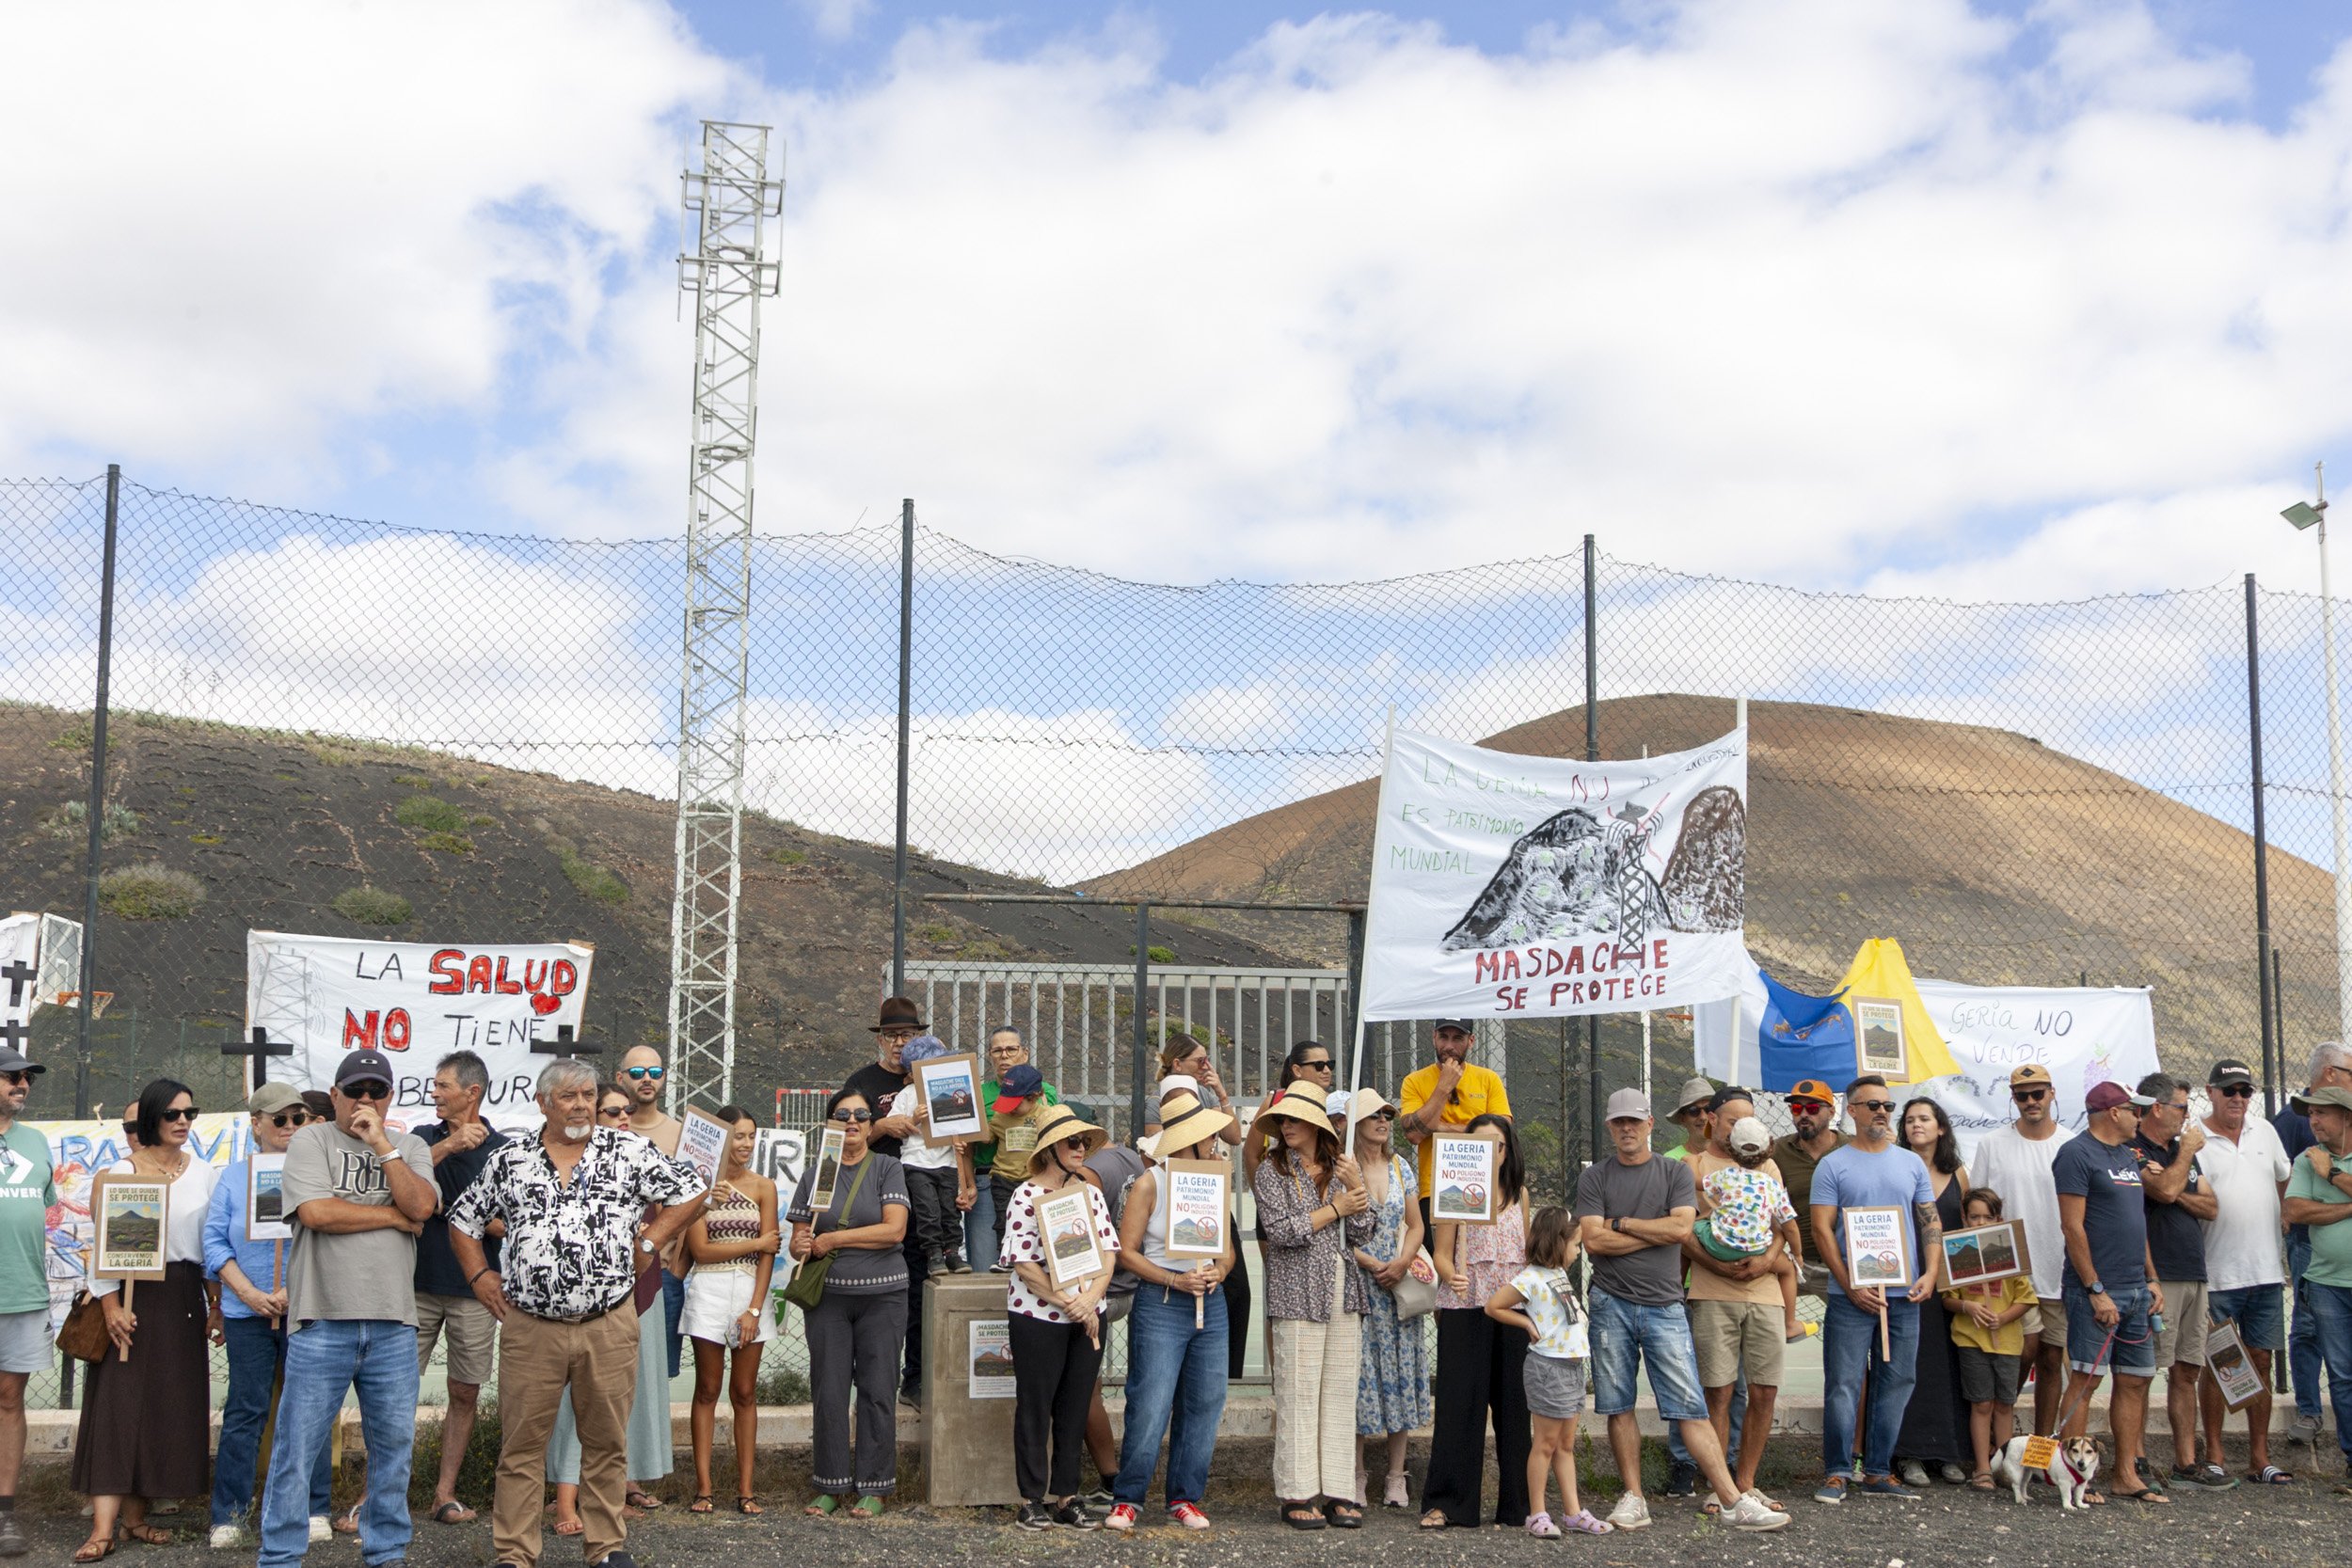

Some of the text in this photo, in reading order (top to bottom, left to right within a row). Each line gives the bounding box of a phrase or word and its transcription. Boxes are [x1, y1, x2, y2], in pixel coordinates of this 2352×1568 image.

[1423, 755, 1457, 787] LA
[1402, 804, 1430, 824] ES
[1475, 939, 1669, 984] MASDACHE
[357, 949, 577, 995] LA SALUD
[1495, 974, 1666, 1011] SE PROTEGE
[343, 1006, 412, 1052] NO
[2034, 1010, 2073, 1037] NO
[1974, 1035, 2051, 1066] VENDE
[688, 1128, 717, 1147] PATRIMONIO
[691, 1117, 721, 1140] LA GERIA
[683, 1143, 694, 1155] NO
[1442, 1153, 1483, 1162] PATRIMONIO
[1443, 1143, 1485, 1153] LA GERIA
[1178, 1176, 1216, 1187] LA GERIA
[1441, 1169, 1455, 1180] NO
[1177, 1186, 1215, 1195] PATRIMONIO
[1176, 1203, 1189, 1212] NO
[1853, 1214, 1892, 1224] LA GERIA
[1856, 1240, 1868, 1249] NO
